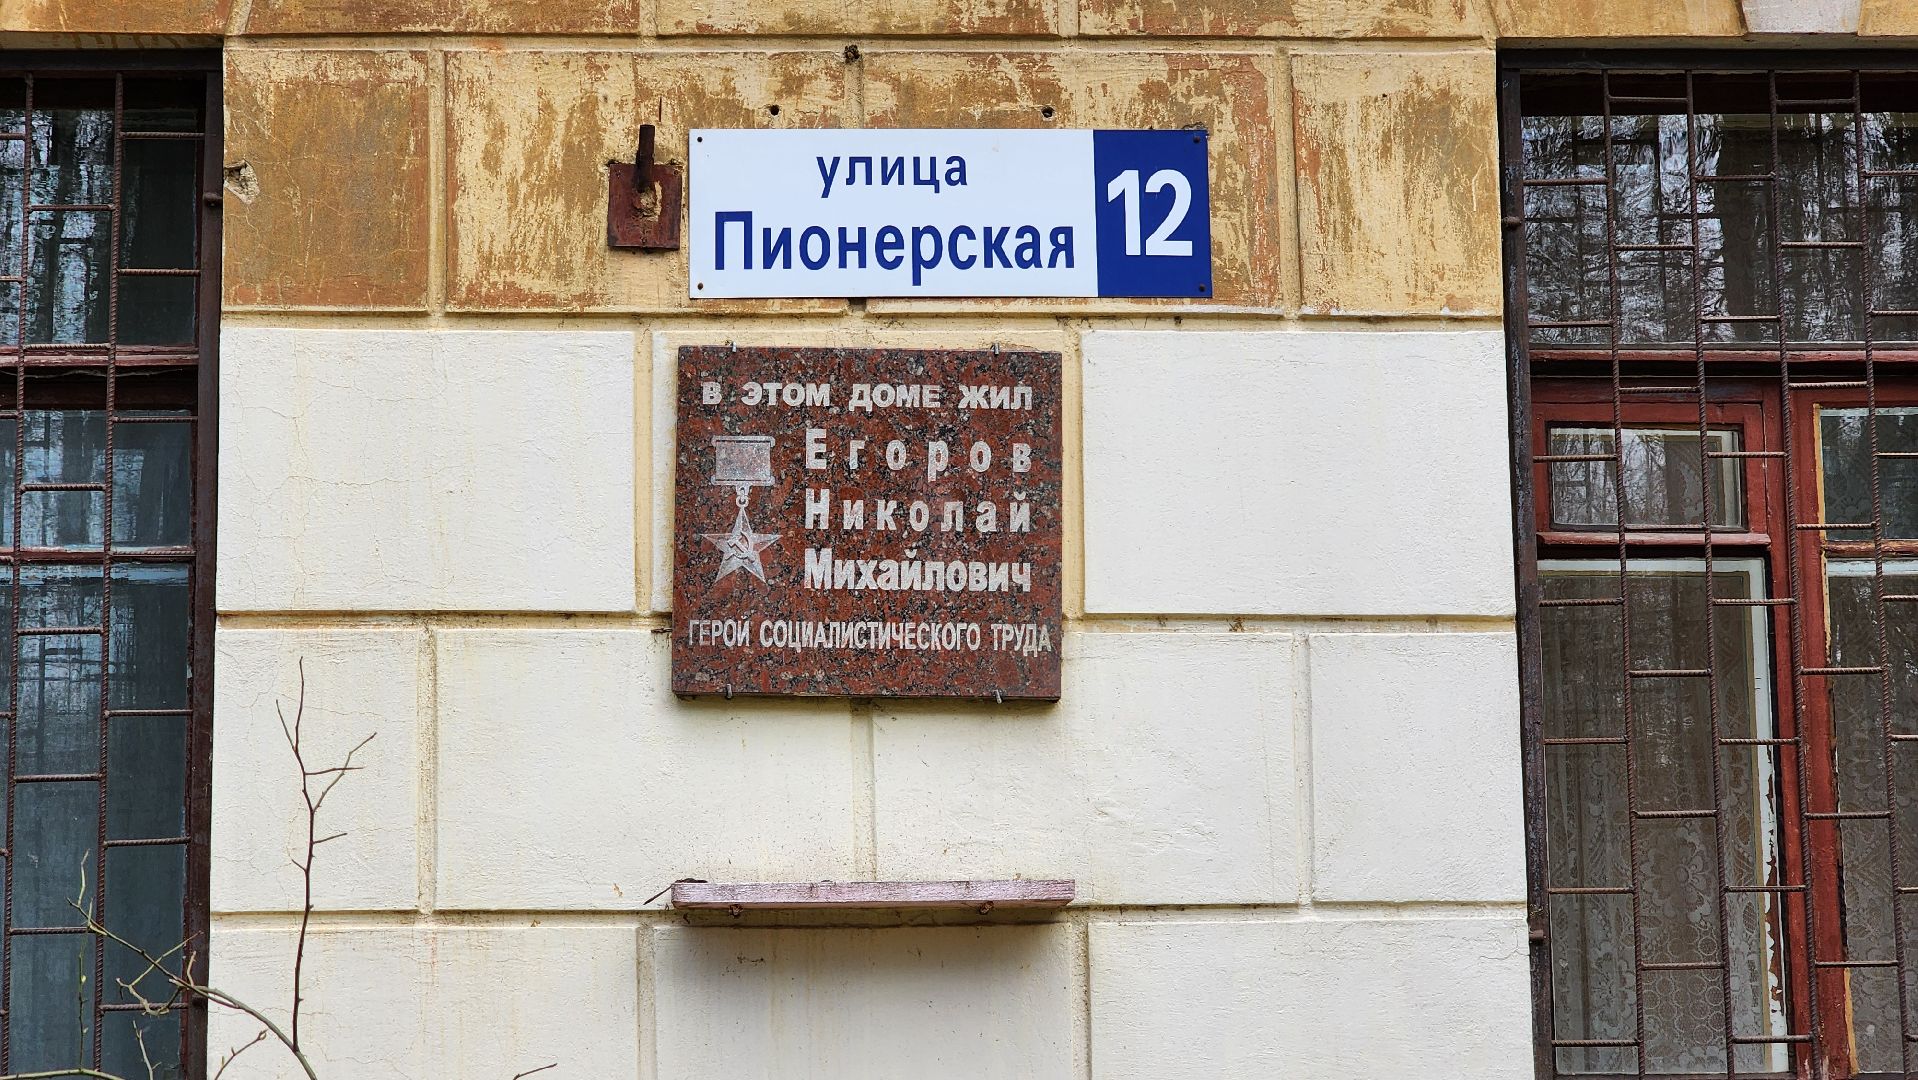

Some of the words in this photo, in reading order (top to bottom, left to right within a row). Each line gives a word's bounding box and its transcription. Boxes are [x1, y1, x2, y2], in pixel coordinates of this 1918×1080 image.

[816, 155, 968, 198] улица
[1106, 168, 1194, 257] 12
[714, 211, 1075, 286] Пионерская
[702, 382, 722, 406] В
[741, 382, 831, 407] ЭТОМ
[848, 383, 941, 411] ДОМЕ
[958, 384, 1033, 411] ЖИЛ
[805, 429, 1032, 482] Егоров
[804, 488, 1031, 533] Николай
[804, 548, 1032, 592] Михайлович
[688, 615, 750, 647] ГЕРОЙ
[760, 619, 980, 654] СОЦИАЛИСТИЧЕСКОГО
[991, 623, 1052, 658] ТРУДА
